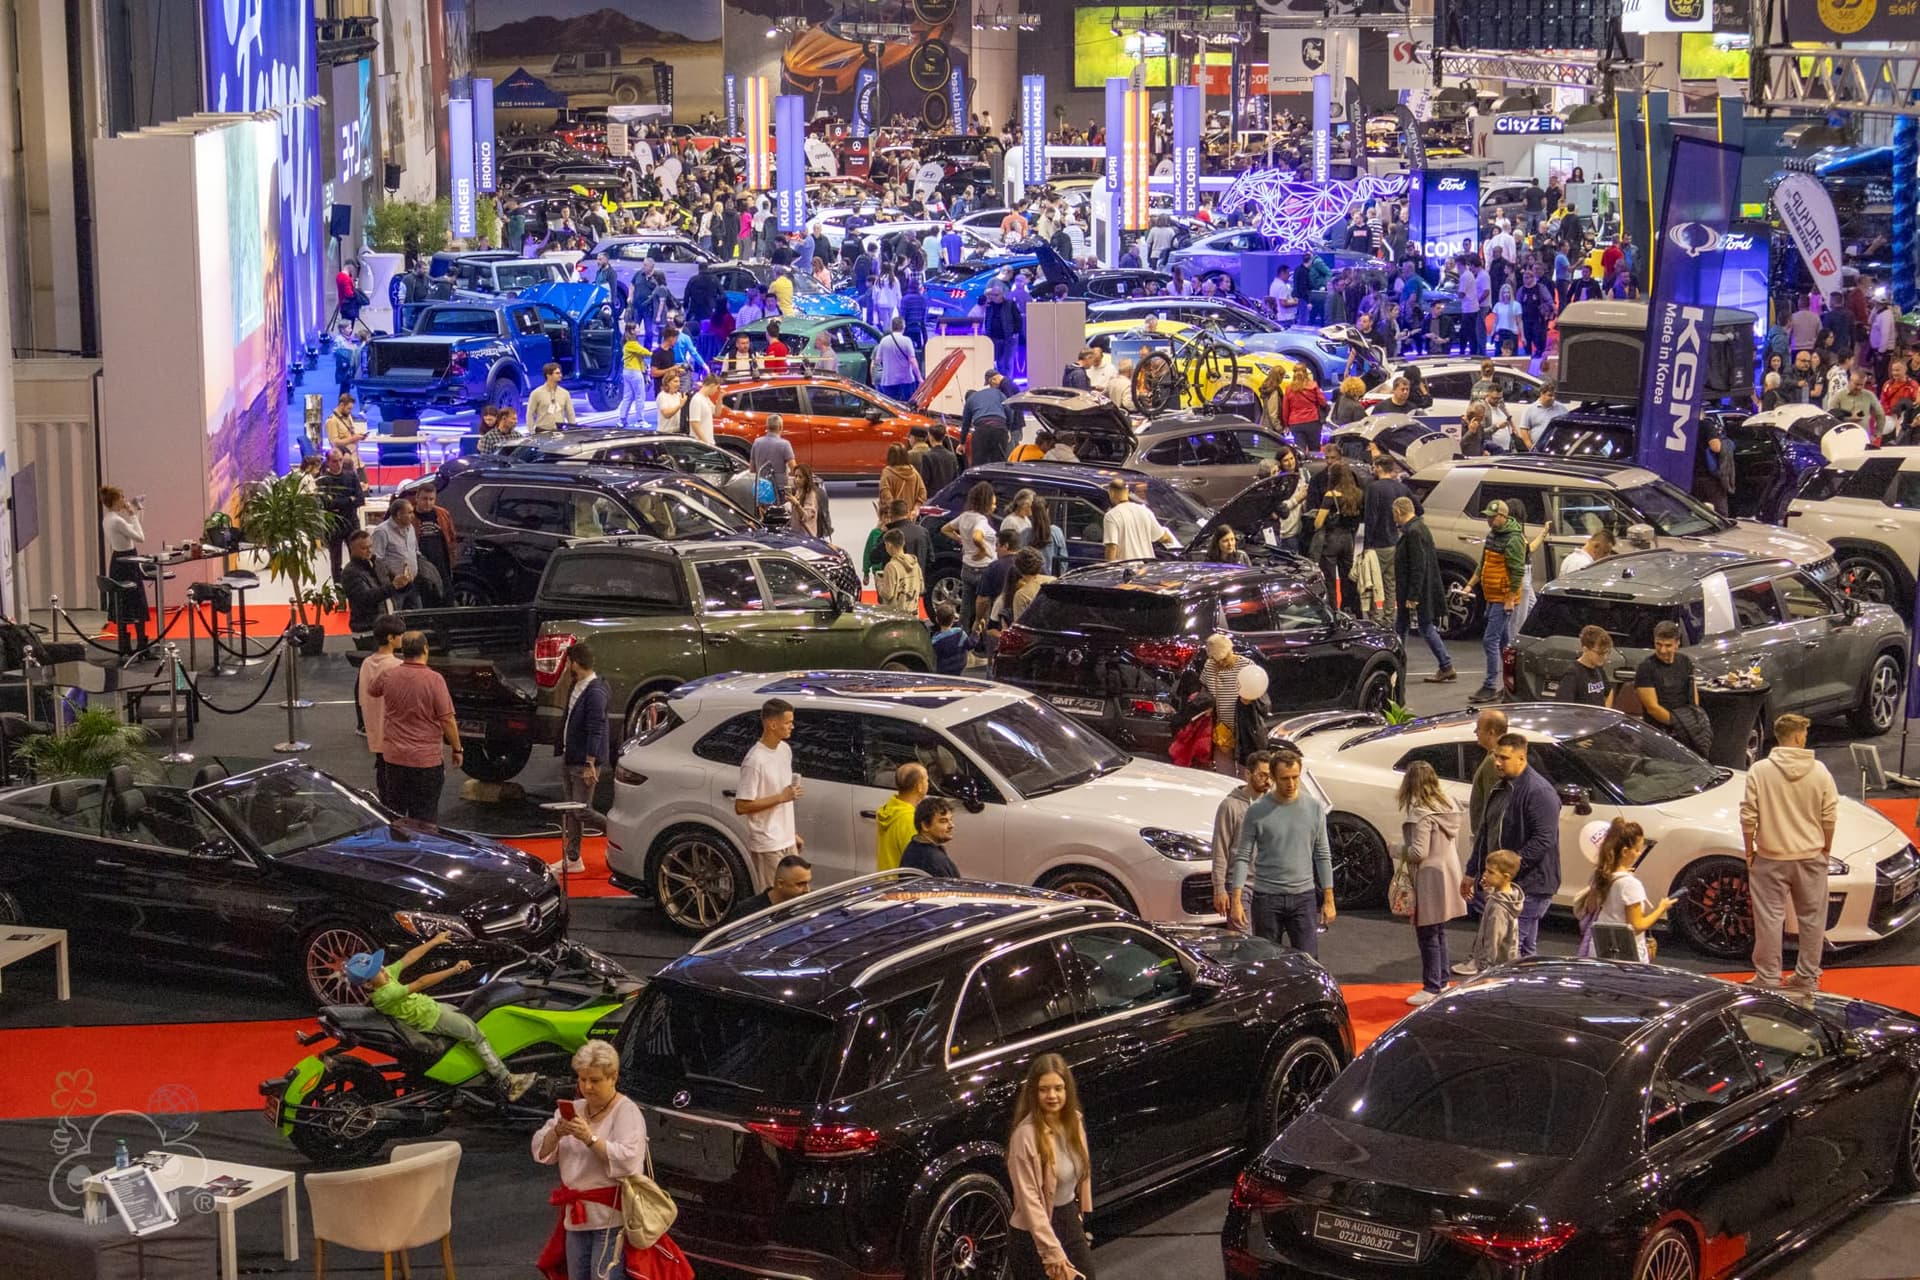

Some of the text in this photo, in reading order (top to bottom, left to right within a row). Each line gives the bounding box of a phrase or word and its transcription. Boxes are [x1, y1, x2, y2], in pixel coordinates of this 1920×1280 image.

[1033, 85, 1042, 181] MUSTANG MACH-E
[482, 142, 491, 189] BRONCO
[1109, 155, 1117, 189] CAPRI
[1317, 129, 1326, 183] MUSTANG
[1186, 147, 1196, 211] EXPLORER
[1438, 177, 1467, 191] Ford
[459, 178, 469, 233] RANGER
[781, 190, 790, 227] KUGA
[795, 190, 803, 226] KUGA
[1719, 233, 1753, 250] Ford
[1654, 303, 1679, 405] Made in Korea
[1665, 306, 1704, 451] KGM
[1333, 1217, 1402, 1241] DON AUTOMOBILE
[1339, 1230, 1393, 1250] 0721.800.877
